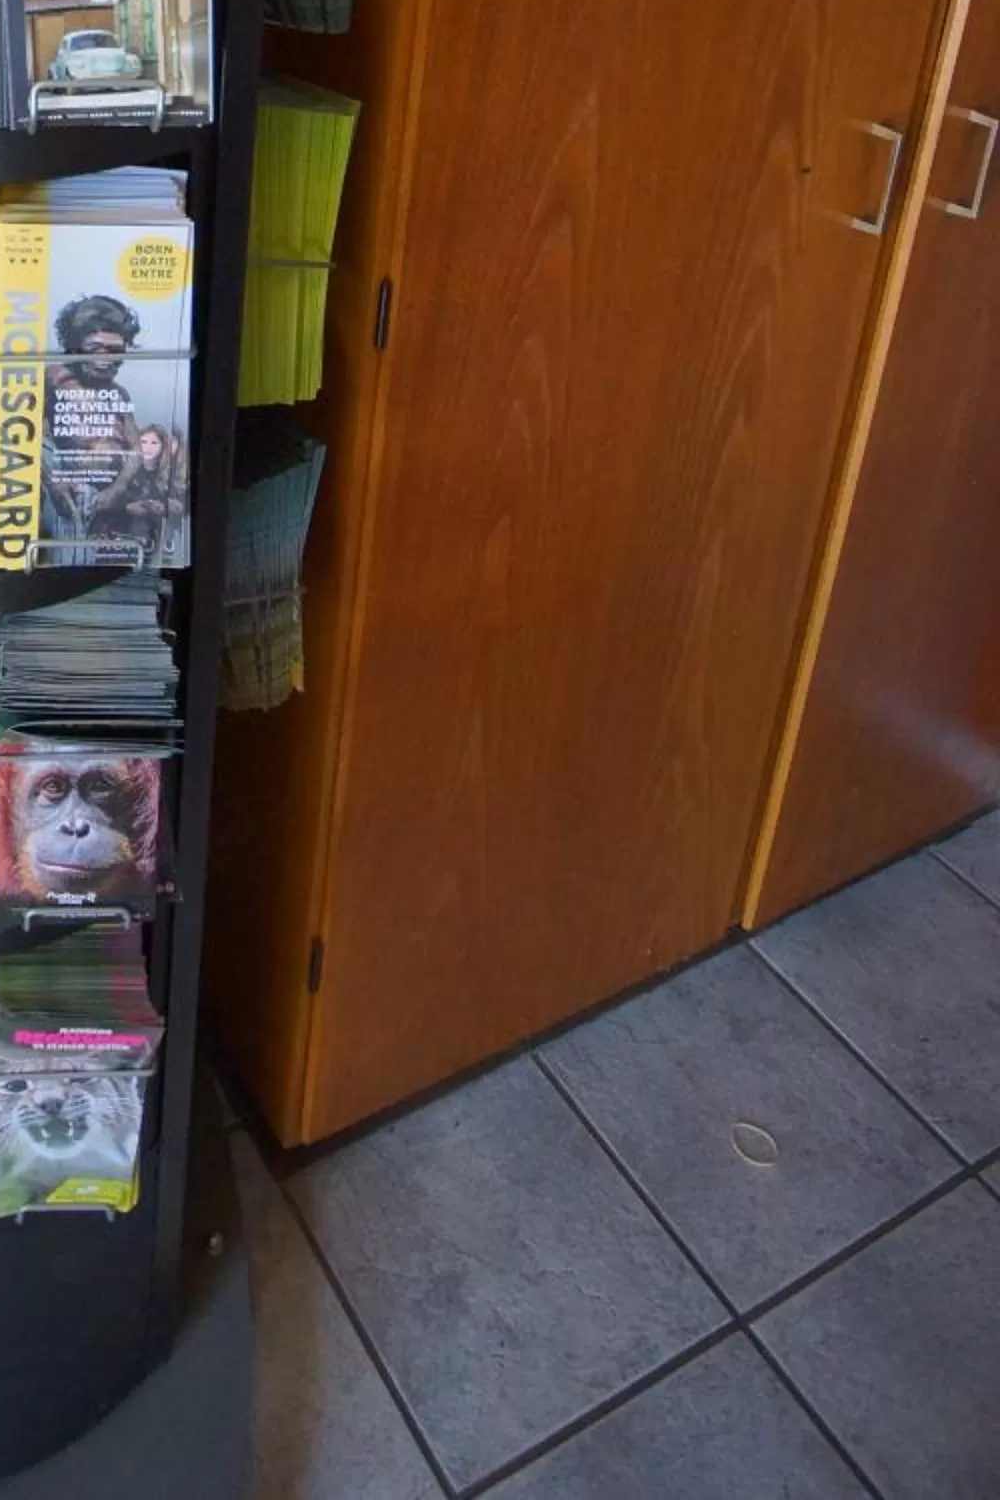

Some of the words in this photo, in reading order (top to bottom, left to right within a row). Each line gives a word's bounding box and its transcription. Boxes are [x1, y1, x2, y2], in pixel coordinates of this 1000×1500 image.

[129, 256, 177, 267] GRATIS
[55, 389, 95, 400] VIDEN
[99, 389, 119, 400] OG
[54, 401, 135, 412] OPLEVELSER
[54, 414, 81, 425] FOR
[83, 414, 116, 425] HELE
[53, 426, 114, 437] FAMILIEN
